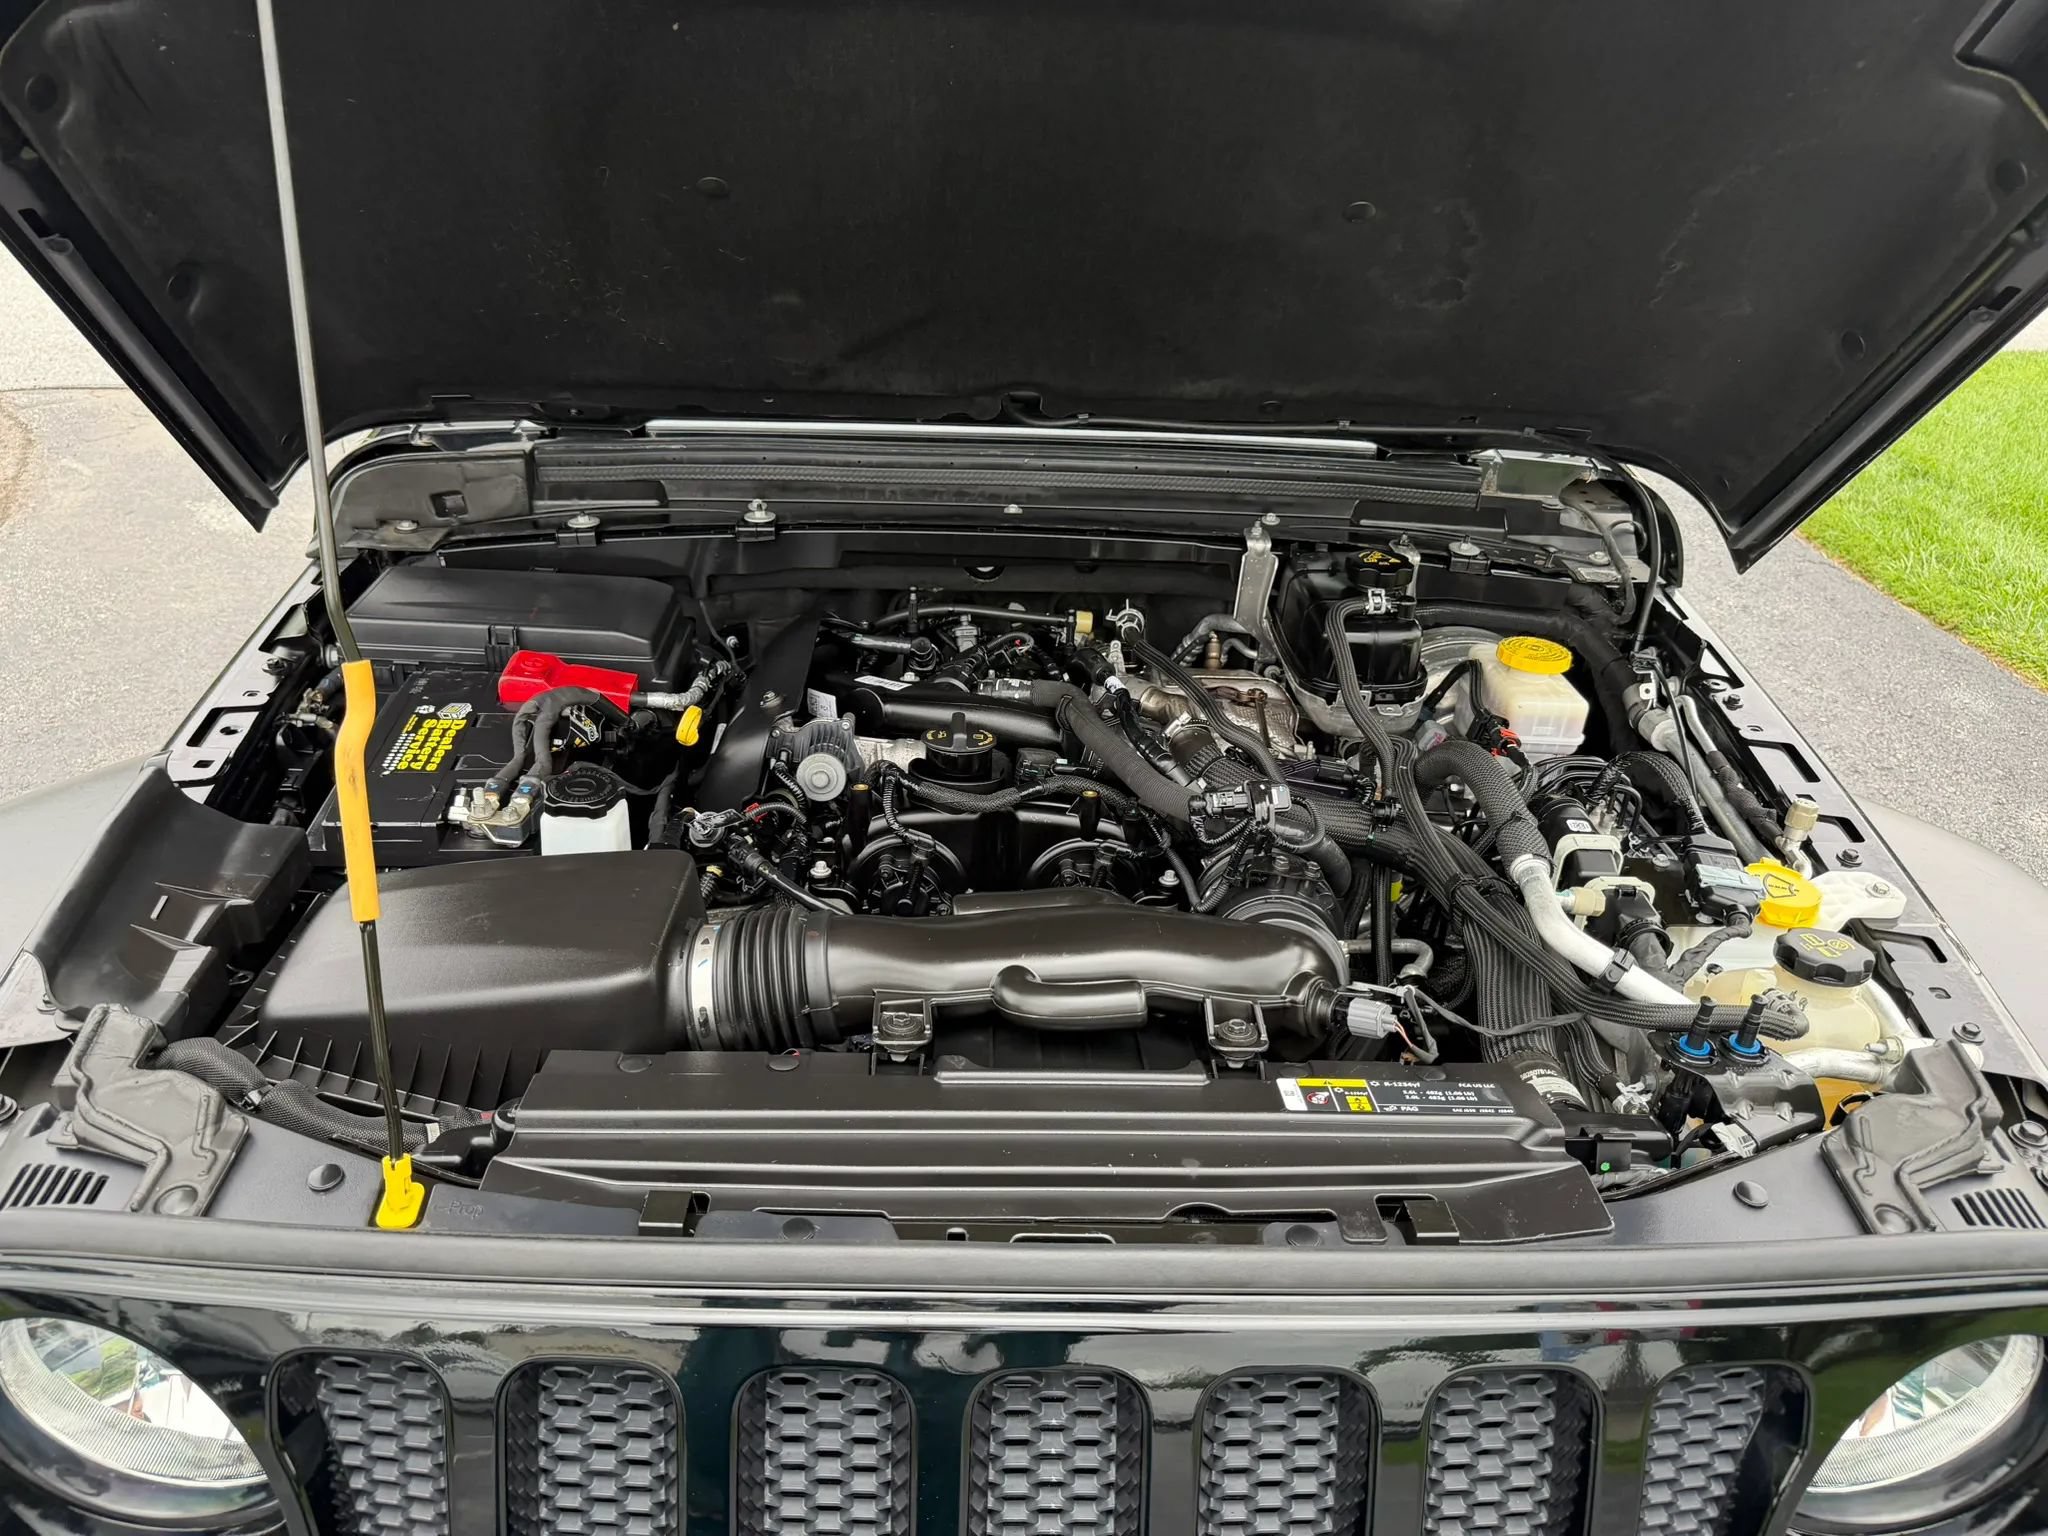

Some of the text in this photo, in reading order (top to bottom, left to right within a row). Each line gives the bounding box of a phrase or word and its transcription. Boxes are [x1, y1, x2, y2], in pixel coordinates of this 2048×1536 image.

[397, 719, 437, 770] Service
[410, 719, 452, 770] Battery
[425, 720, 467, 771] Dealers
[447, 1199, 485, 1220] Prop
